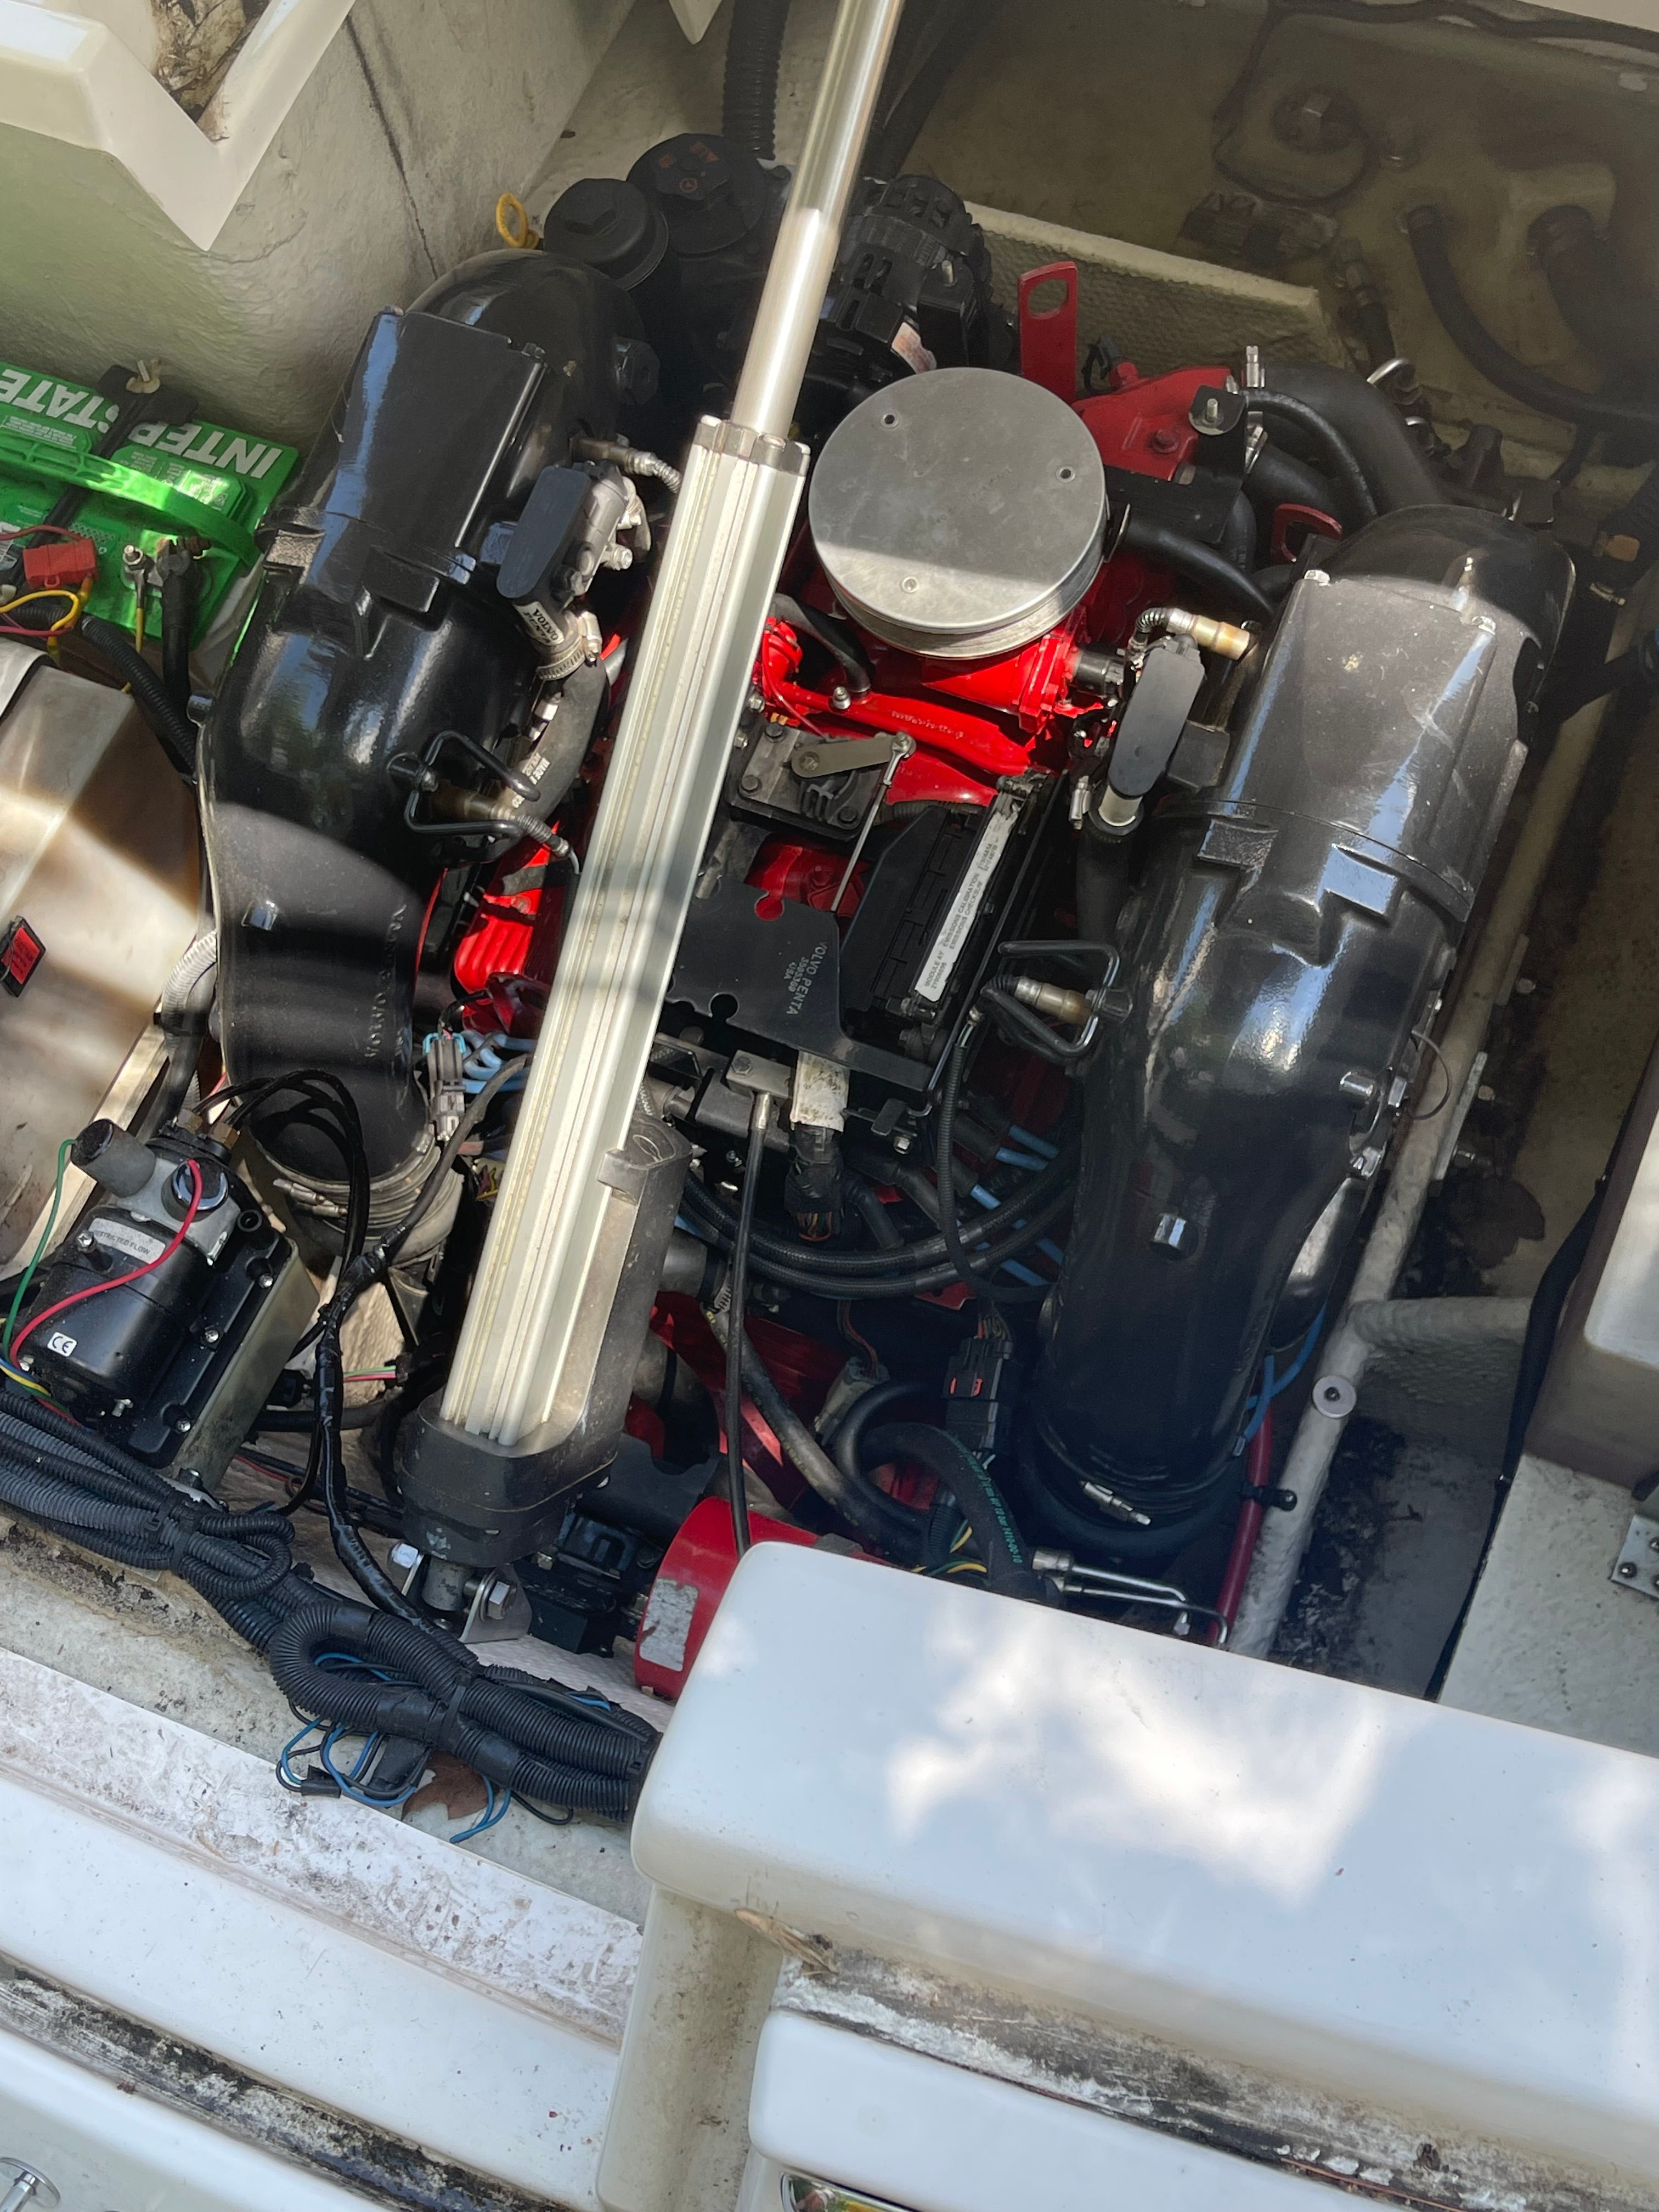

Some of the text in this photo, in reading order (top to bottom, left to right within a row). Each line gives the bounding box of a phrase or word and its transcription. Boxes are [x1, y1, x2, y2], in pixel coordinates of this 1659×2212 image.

[533, 608, 558, 640] VOLVO
[924, 961, 940, 986] MODULE
[958, 873, 979, 913] CALIBRATION
[783, 962, 797, 979] USA
[786, 941, 828, 1014] VOLVO PENTA
[129, 1242, 150, 1255] FLOW
[52, 1336, 74, 1353] CE
